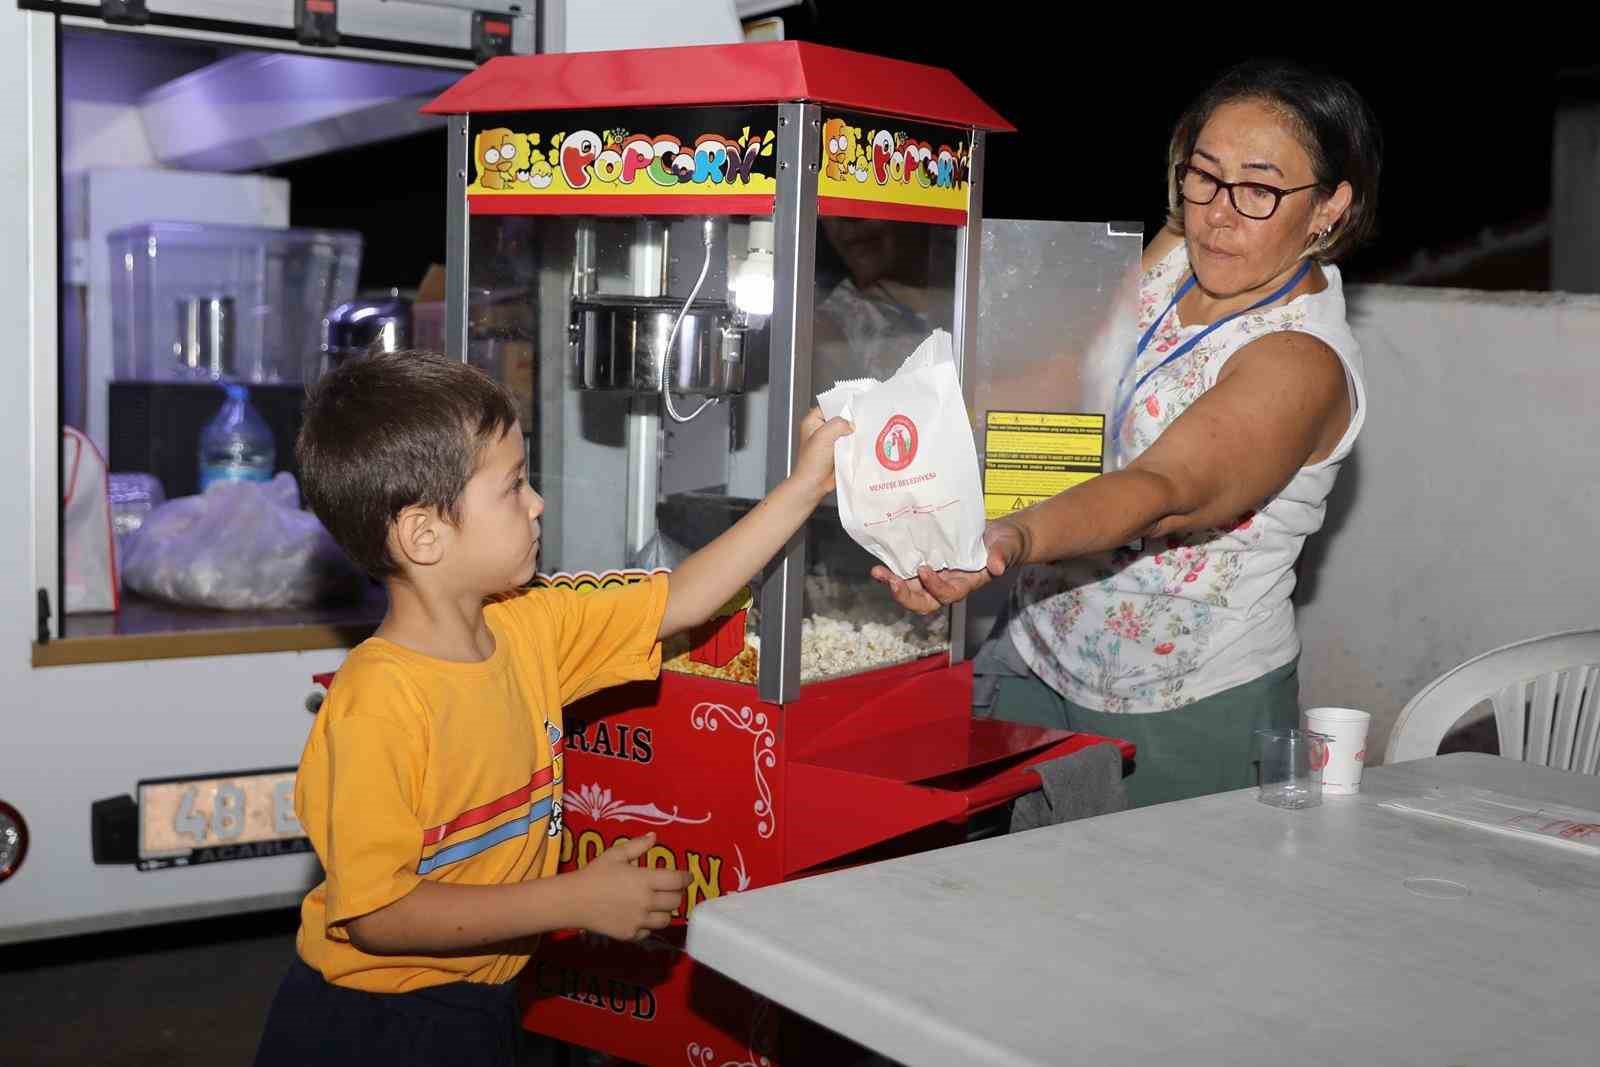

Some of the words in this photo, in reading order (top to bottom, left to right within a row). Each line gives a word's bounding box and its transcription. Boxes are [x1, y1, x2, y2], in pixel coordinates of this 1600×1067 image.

[560, 129, 759, 189] POPCORN
[873, 130, 969, 190] POPCORN
[175, 782, 246, 843] 48
